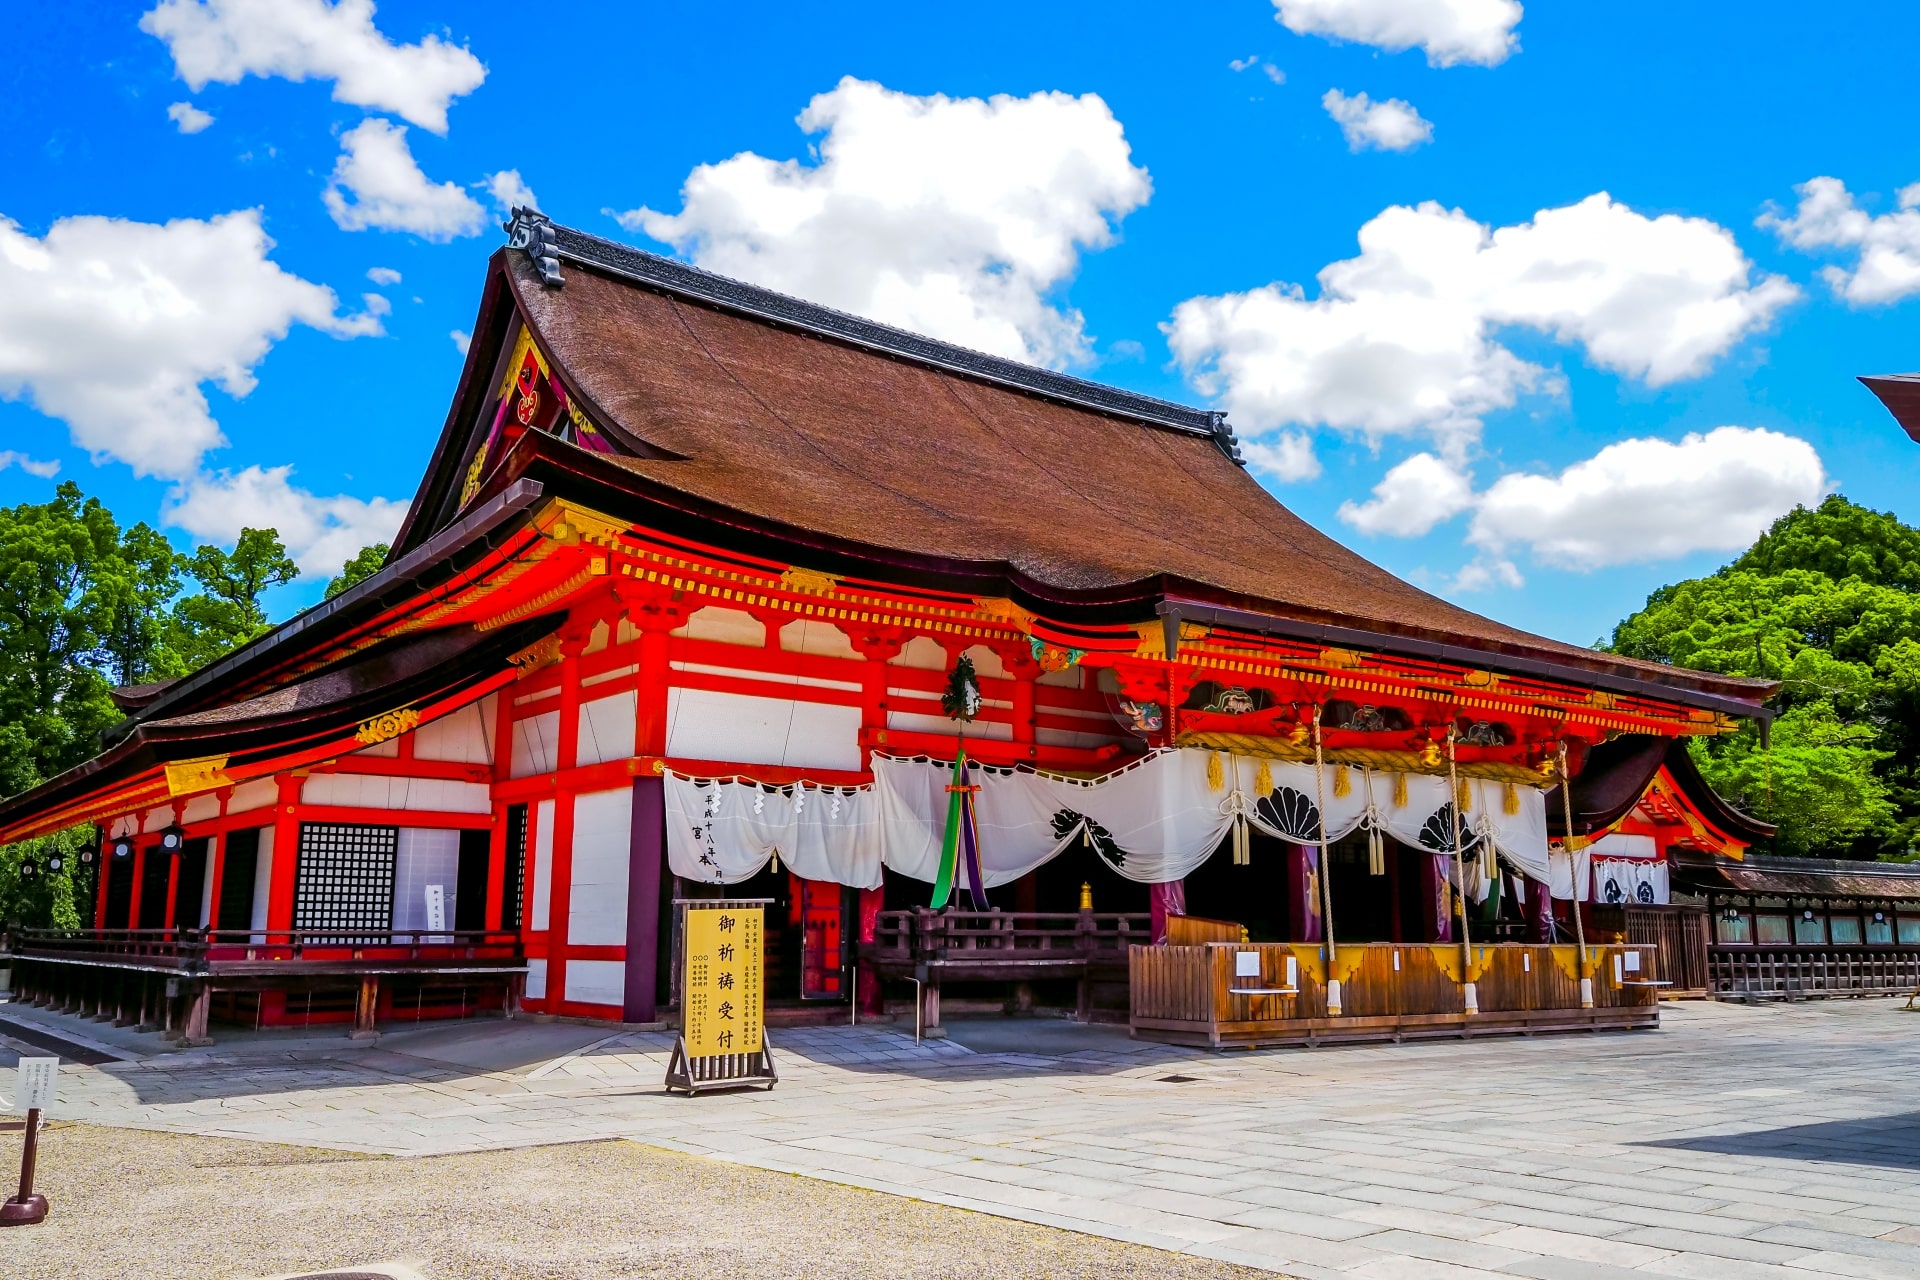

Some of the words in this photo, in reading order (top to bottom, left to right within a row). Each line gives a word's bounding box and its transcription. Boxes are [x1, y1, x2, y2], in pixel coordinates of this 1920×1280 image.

[716, 914, 736, 1049] 御祈祷受付
